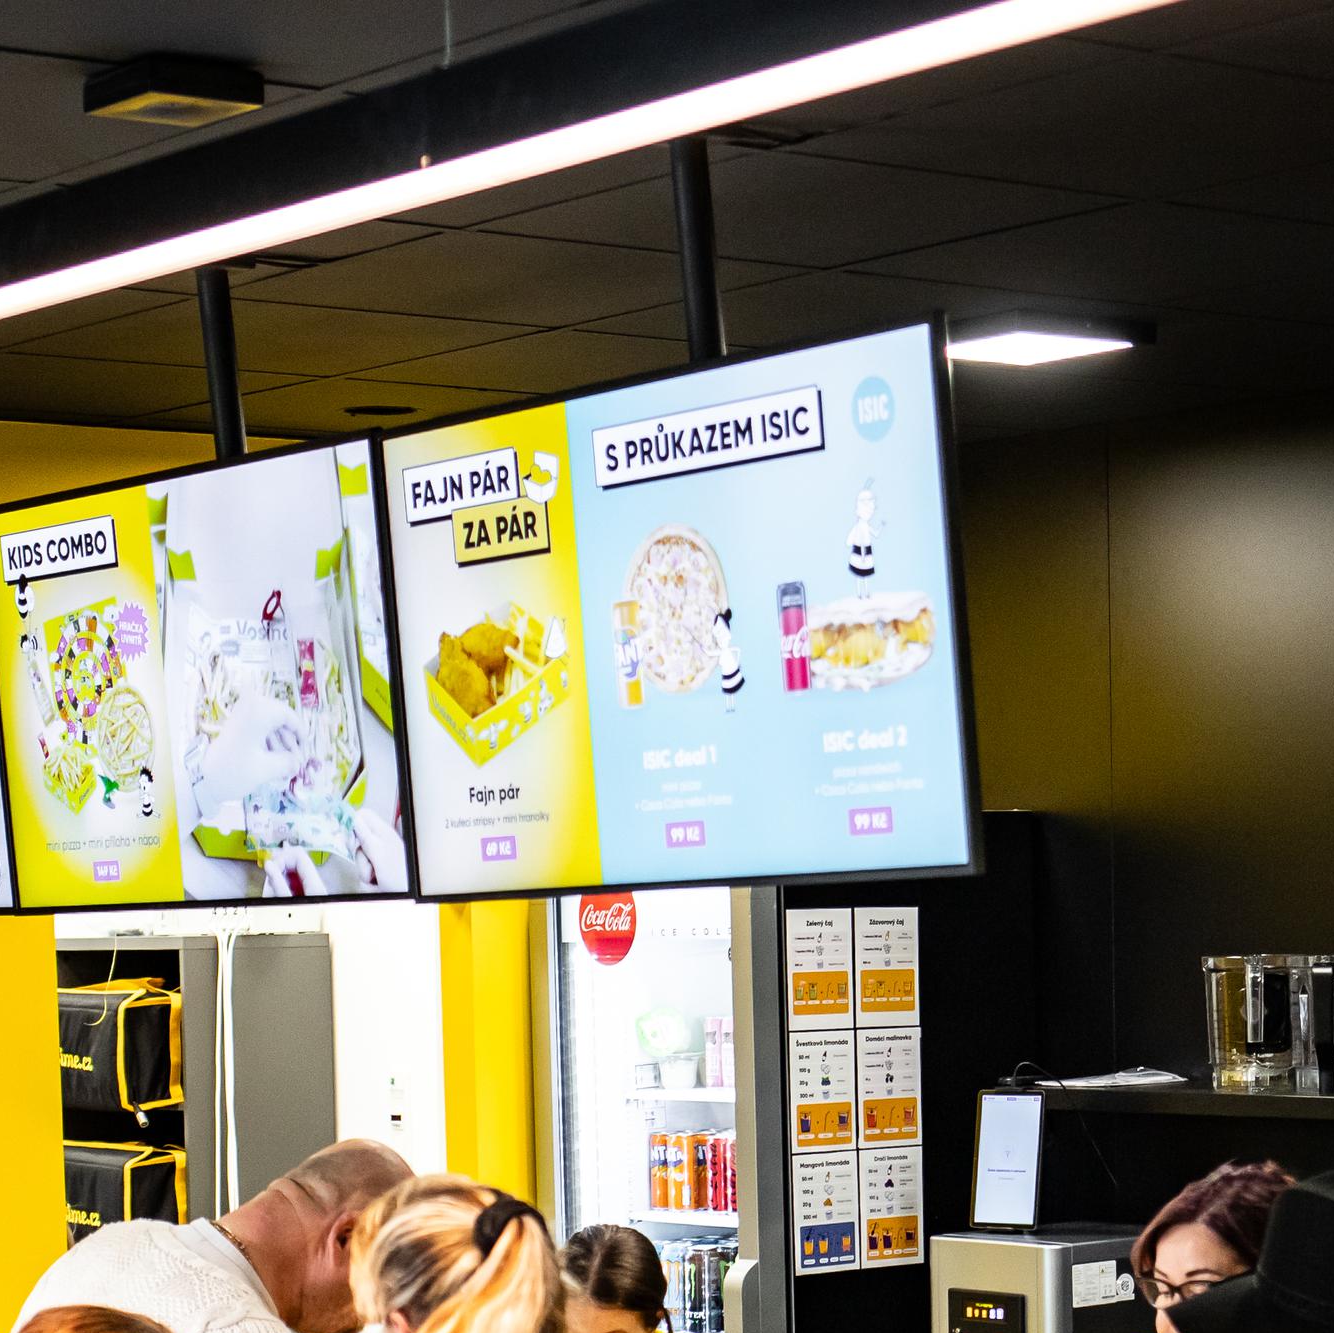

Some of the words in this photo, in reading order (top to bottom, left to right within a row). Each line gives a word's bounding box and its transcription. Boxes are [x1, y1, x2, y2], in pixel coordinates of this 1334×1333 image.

[858, 394, 889, 425] ISIC
[606, 444, 618, 471] S
[625, 417, 753, 468] PRŮKAZEM
[761, 407, 809, 442] ISIC
[412, 474, 464, 508] FAJN
[469, 460, 510, 497] PÁR
[463, 519, 491, 549] ZA
[496, 506, 537, 543] PÁR
[8, 543, 43, 570] KIDS
[47, 531, 106, 562] COMBO
[823, 729, 855, 752] ISIC
[643, 748, 671, 769] ISIC
[469, 787, 495, 806] Fajn
[500, 784, 520, 804] pár
[62, 841, 81, 853] pizza
[581, 902, 633, 932] Coca-Cola
[651, 928, 677, 936] ICE
